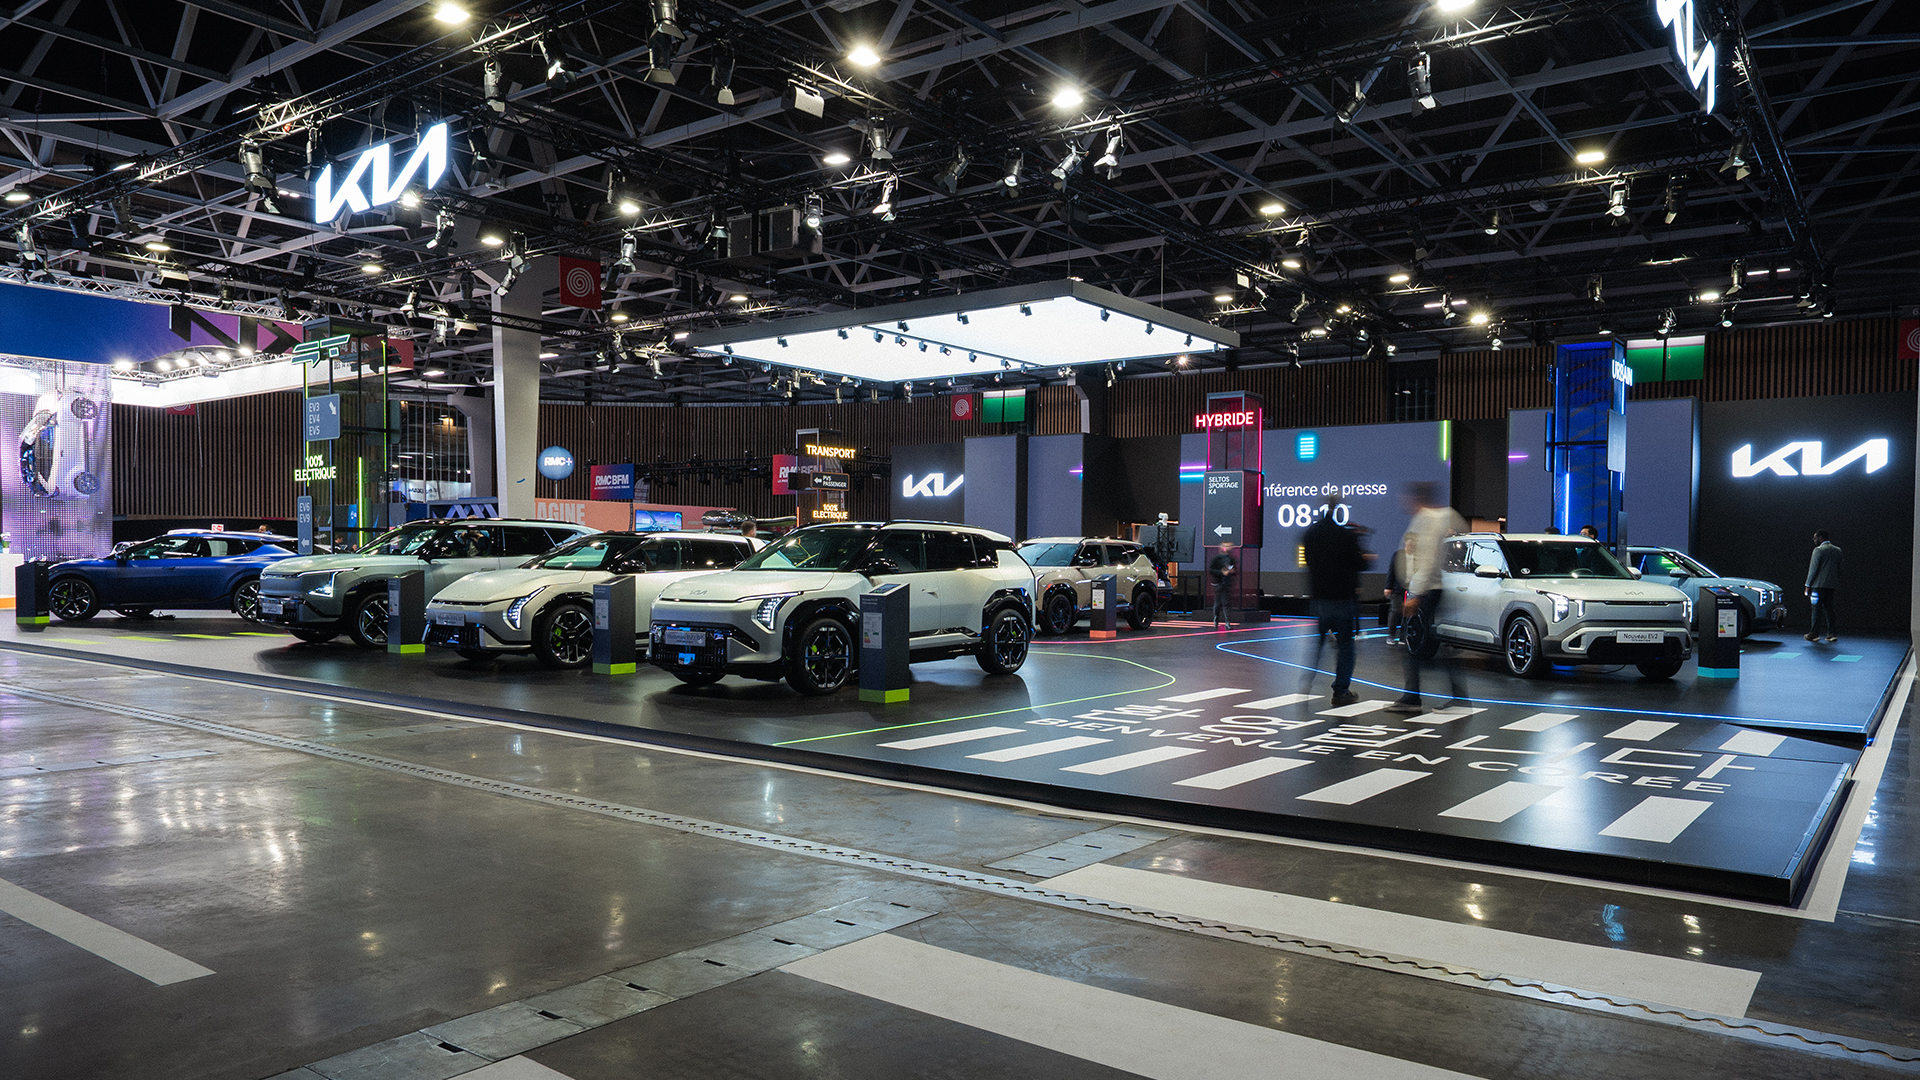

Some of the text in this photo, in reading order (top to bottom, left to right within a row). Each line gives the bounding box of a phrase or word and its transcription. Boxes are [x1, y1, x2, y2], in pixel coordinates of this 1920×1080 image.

[315, 121, 447, 224] KIA
[308, 402, 320, 413] EV3
[308, 414, 320, 425] EV4
[1195, 411, 1255, 428] HYBRIDE
[308, 426, 320, 436] EV5
[805, 444, 856, 459] TRANSPORT
[1732, 438, 1889, 477] KIA
[305, 454, 324, 469] 100%
[1321, 482, 1339, 496] de
[1342, 483, 1388, 499] presse
[299, 502, 311, 512] EV6
[535, 502, 586, 526] AGINE
[822, 503, 839, 512] 100%
[299, 512, 311, 522] EV9
[1024, 717, 1732, 794] BIENVENUE EN CORÉE
